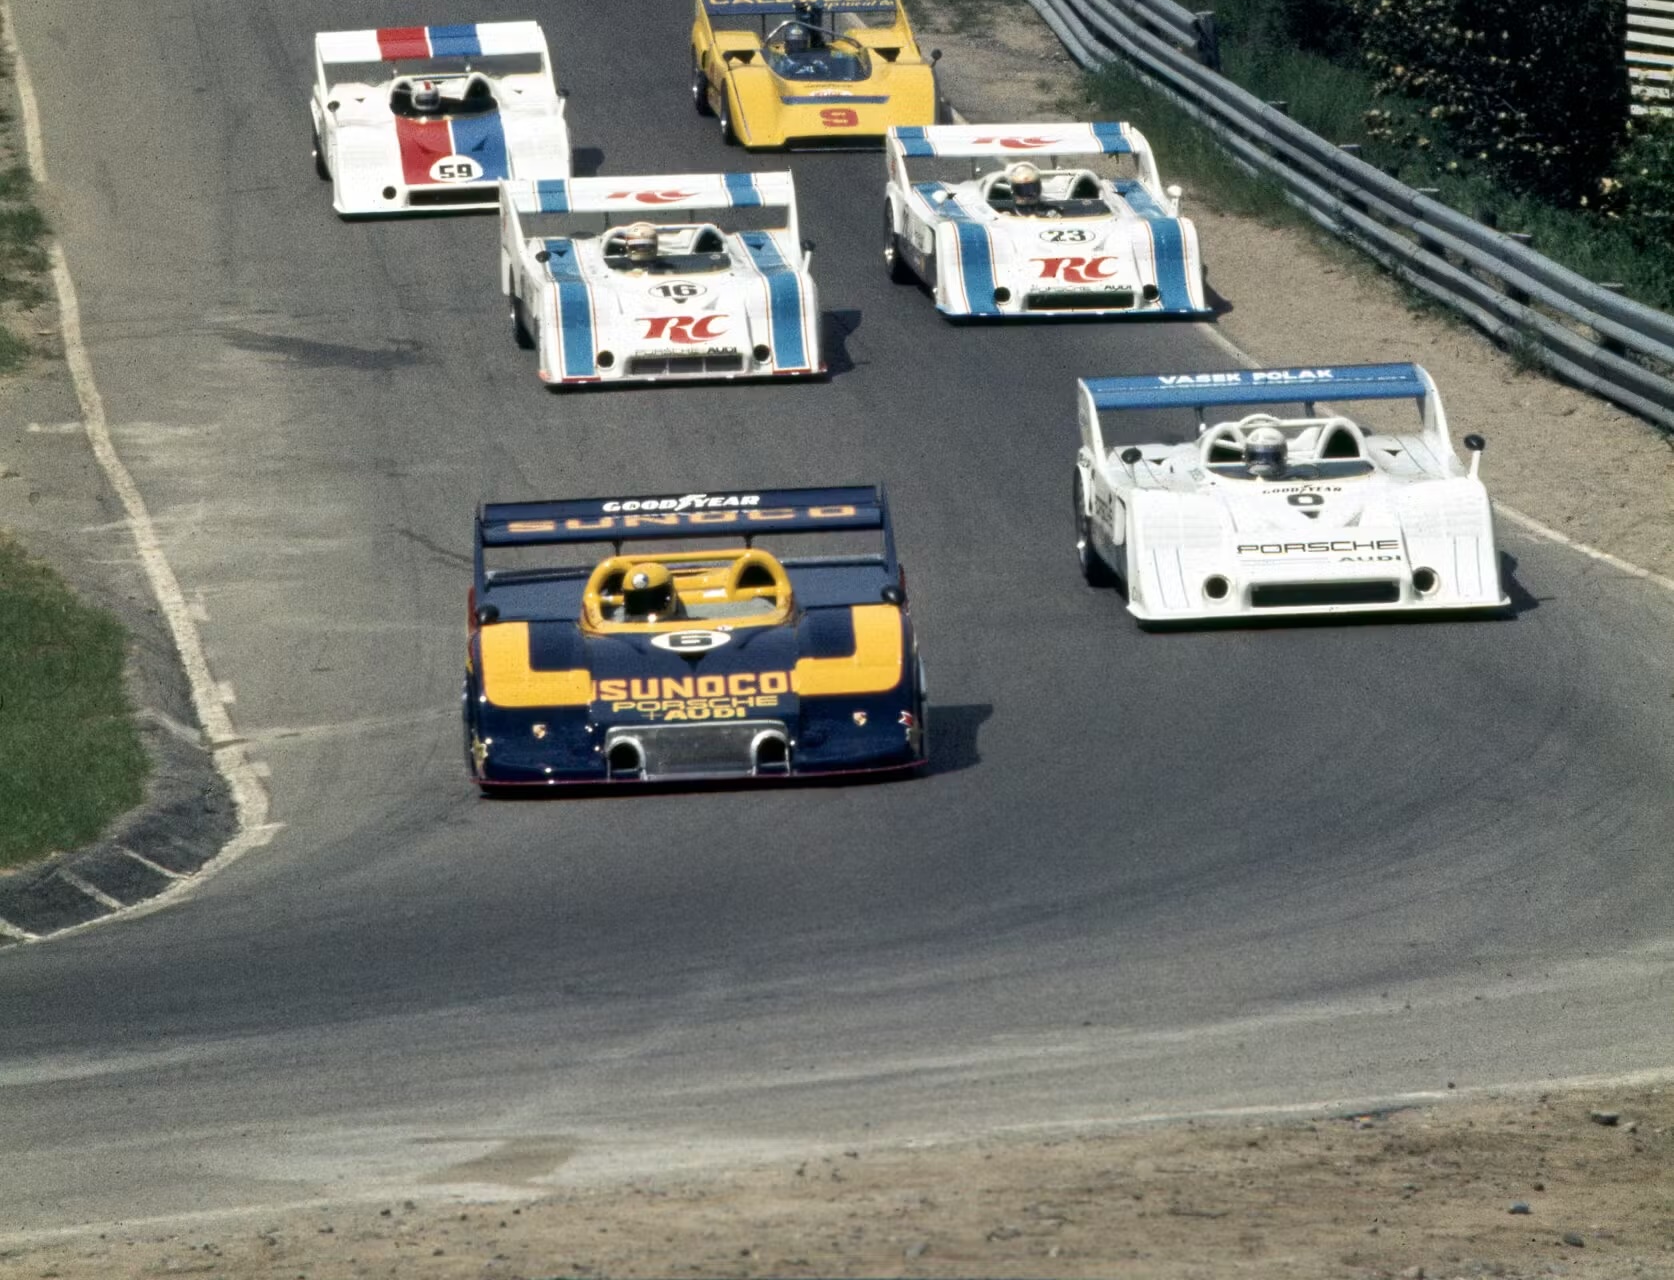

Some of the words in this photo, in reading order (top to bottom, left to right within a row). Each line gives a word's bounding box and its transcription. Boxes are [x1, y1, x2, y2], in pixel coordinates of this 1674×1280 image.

[819, 108, 859, 127] 9
[439, 163, 473, 178] 59
[1047, 229, 1087, 242] 23
[1028, 255, 1119, 284] RC
[656, 283, 698, 297] 16
[634, 313, 730, 344] RC
[1158, 373, 1241, 385] VASEK
[1252, 370, 1334, 381] POLAK
[602, 493, 760, 512] GOODYEAR
[1287, 493, 1325, 506] 0
[508, 505, 856, 532] SUNOCO
[1236, 539, 1400, 554] PORSCHE
[1338, 554, 1402, 562] AUDI
[668, 633, 713, 648] 6
[599, 671, 788, 701] SUNOCO
[612, 695, 779, 713] PORSCHE
